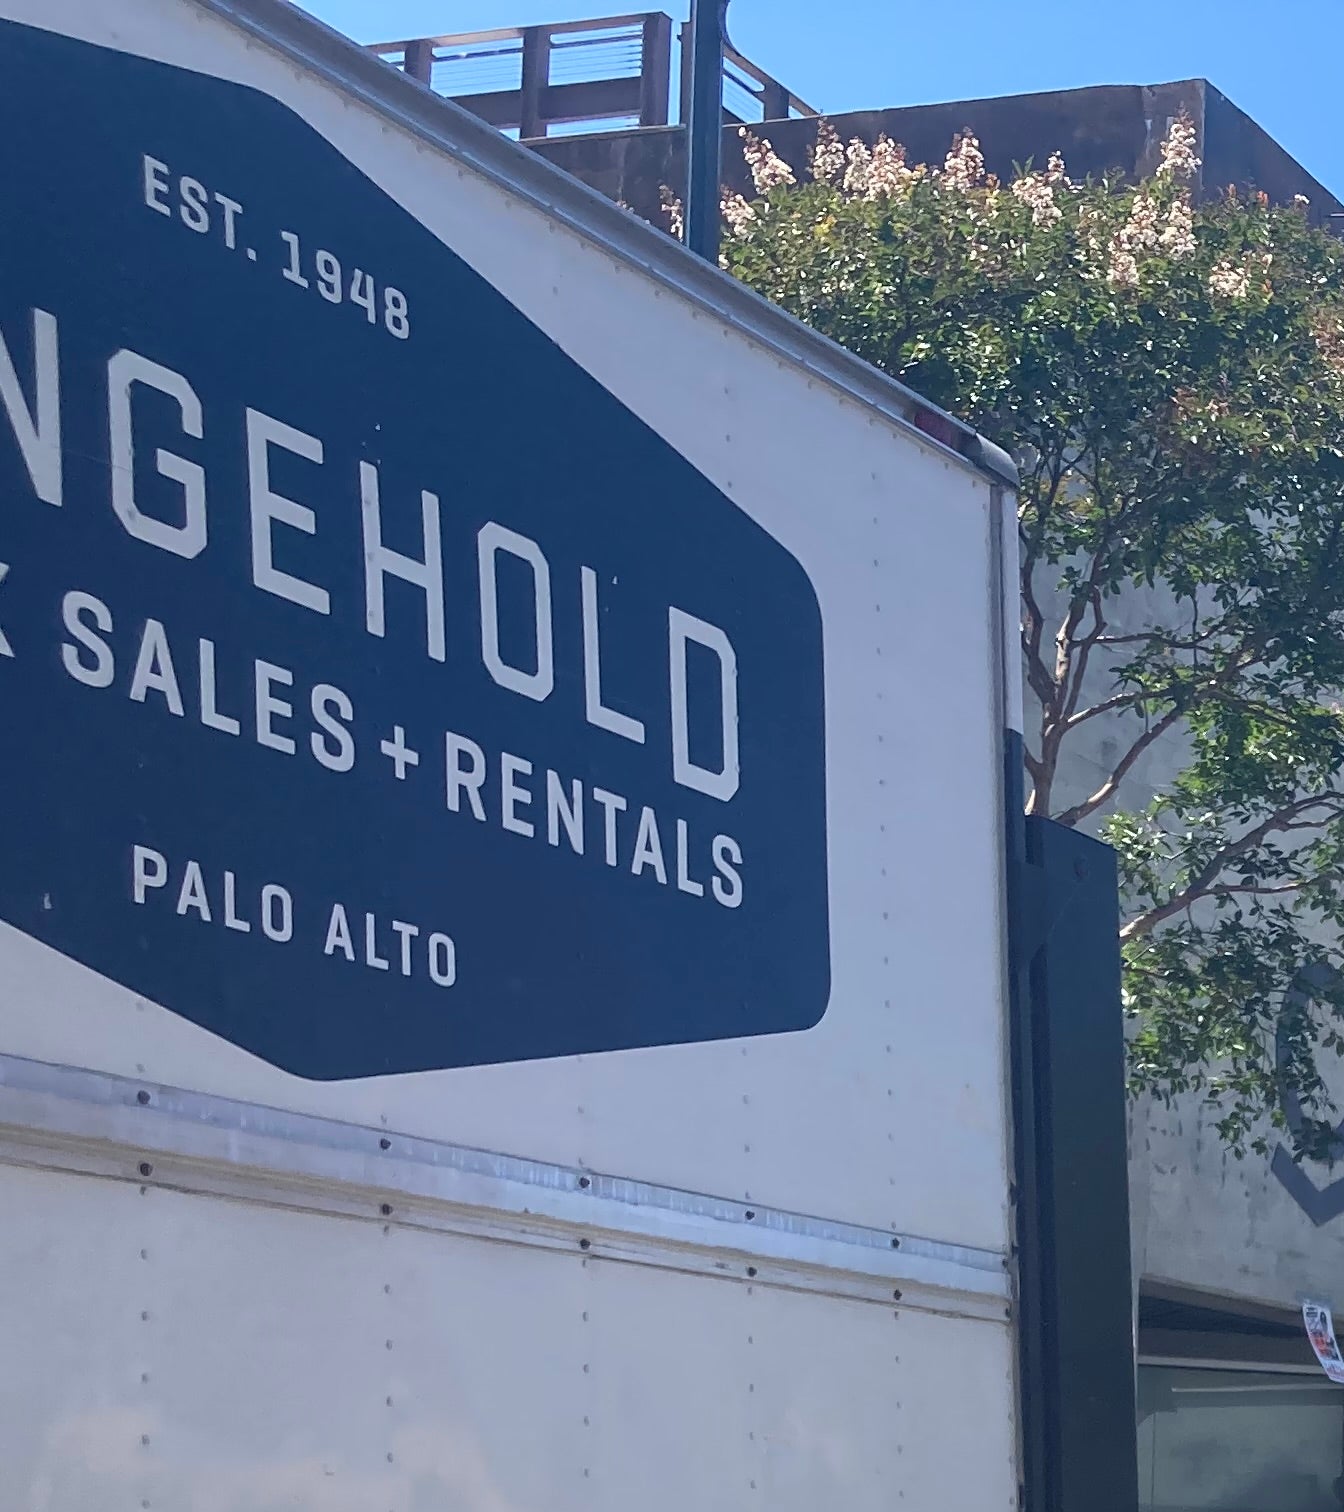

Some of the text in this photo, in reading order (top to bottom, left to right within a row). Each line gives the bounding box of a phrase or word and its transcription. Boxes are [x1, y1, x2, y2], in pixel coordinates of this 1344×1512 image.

[143, 154, 409, 340] EST. 1948
[62, 589, 355, 772] SALES
[446, 731, 743, 908] RENTALS
[133, 844, 456, 987] PALO ALTO
